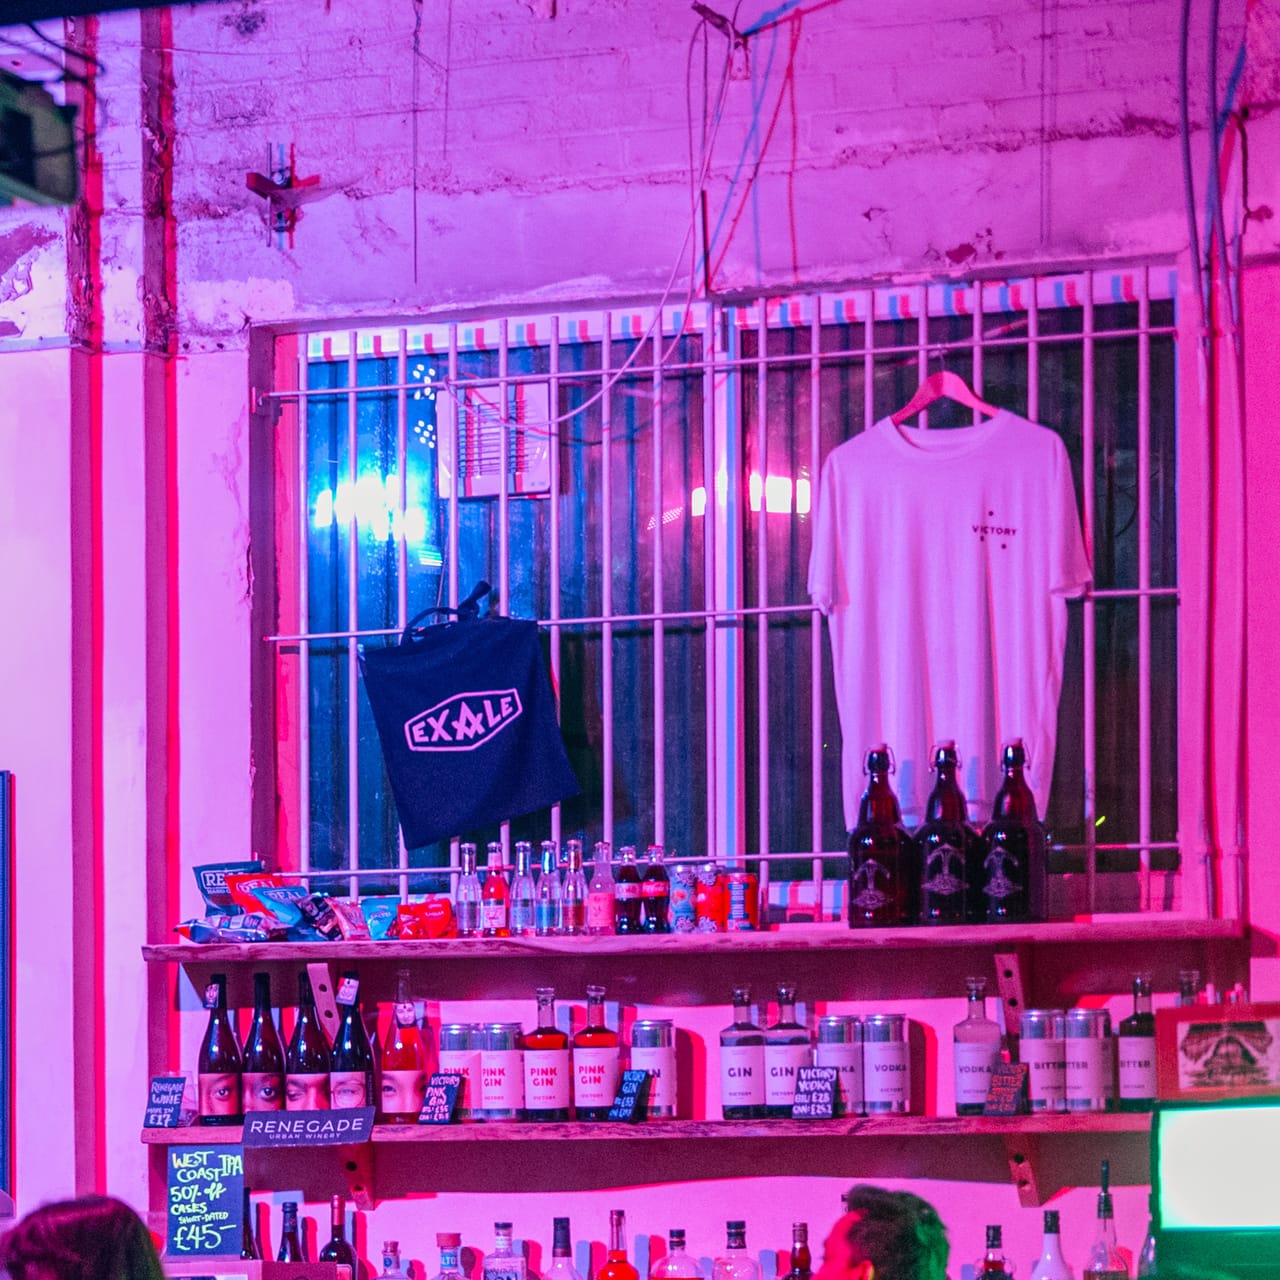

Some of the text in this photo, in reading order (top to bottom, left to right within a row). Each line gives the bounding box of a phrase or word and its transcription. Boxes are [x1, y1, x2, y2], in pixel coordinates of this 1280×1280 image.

[972, 525, 1017, 536] VICTORY
[412, 696, 513, 742] EXALE
[530, 1068, 558, 1077] PINK
[578, 1065, 606, 1074] PINK
[728, 1068, 752, 1078] GIN
[770, 1066, 794, 1077] GIN
[484, 1078, 502, 1087] GIN
[532, 1078, 554, 1086] GIN
[580, 1076, 602, 1085] GIN
[152, 1094, 182, 1105] WINE
[149, 1114, 173, 1127] £17
[250, 1118, 364, 1134] RENEGADE
[305, 1132, 342, 1140] WINERY
[172, 1150, 244, 1176] WEST IPA
[176, 1168, 222, 1183] COAST
[170, 1184, 202, 1203] 50%
[170, 1202, 208, 1216] CASES
